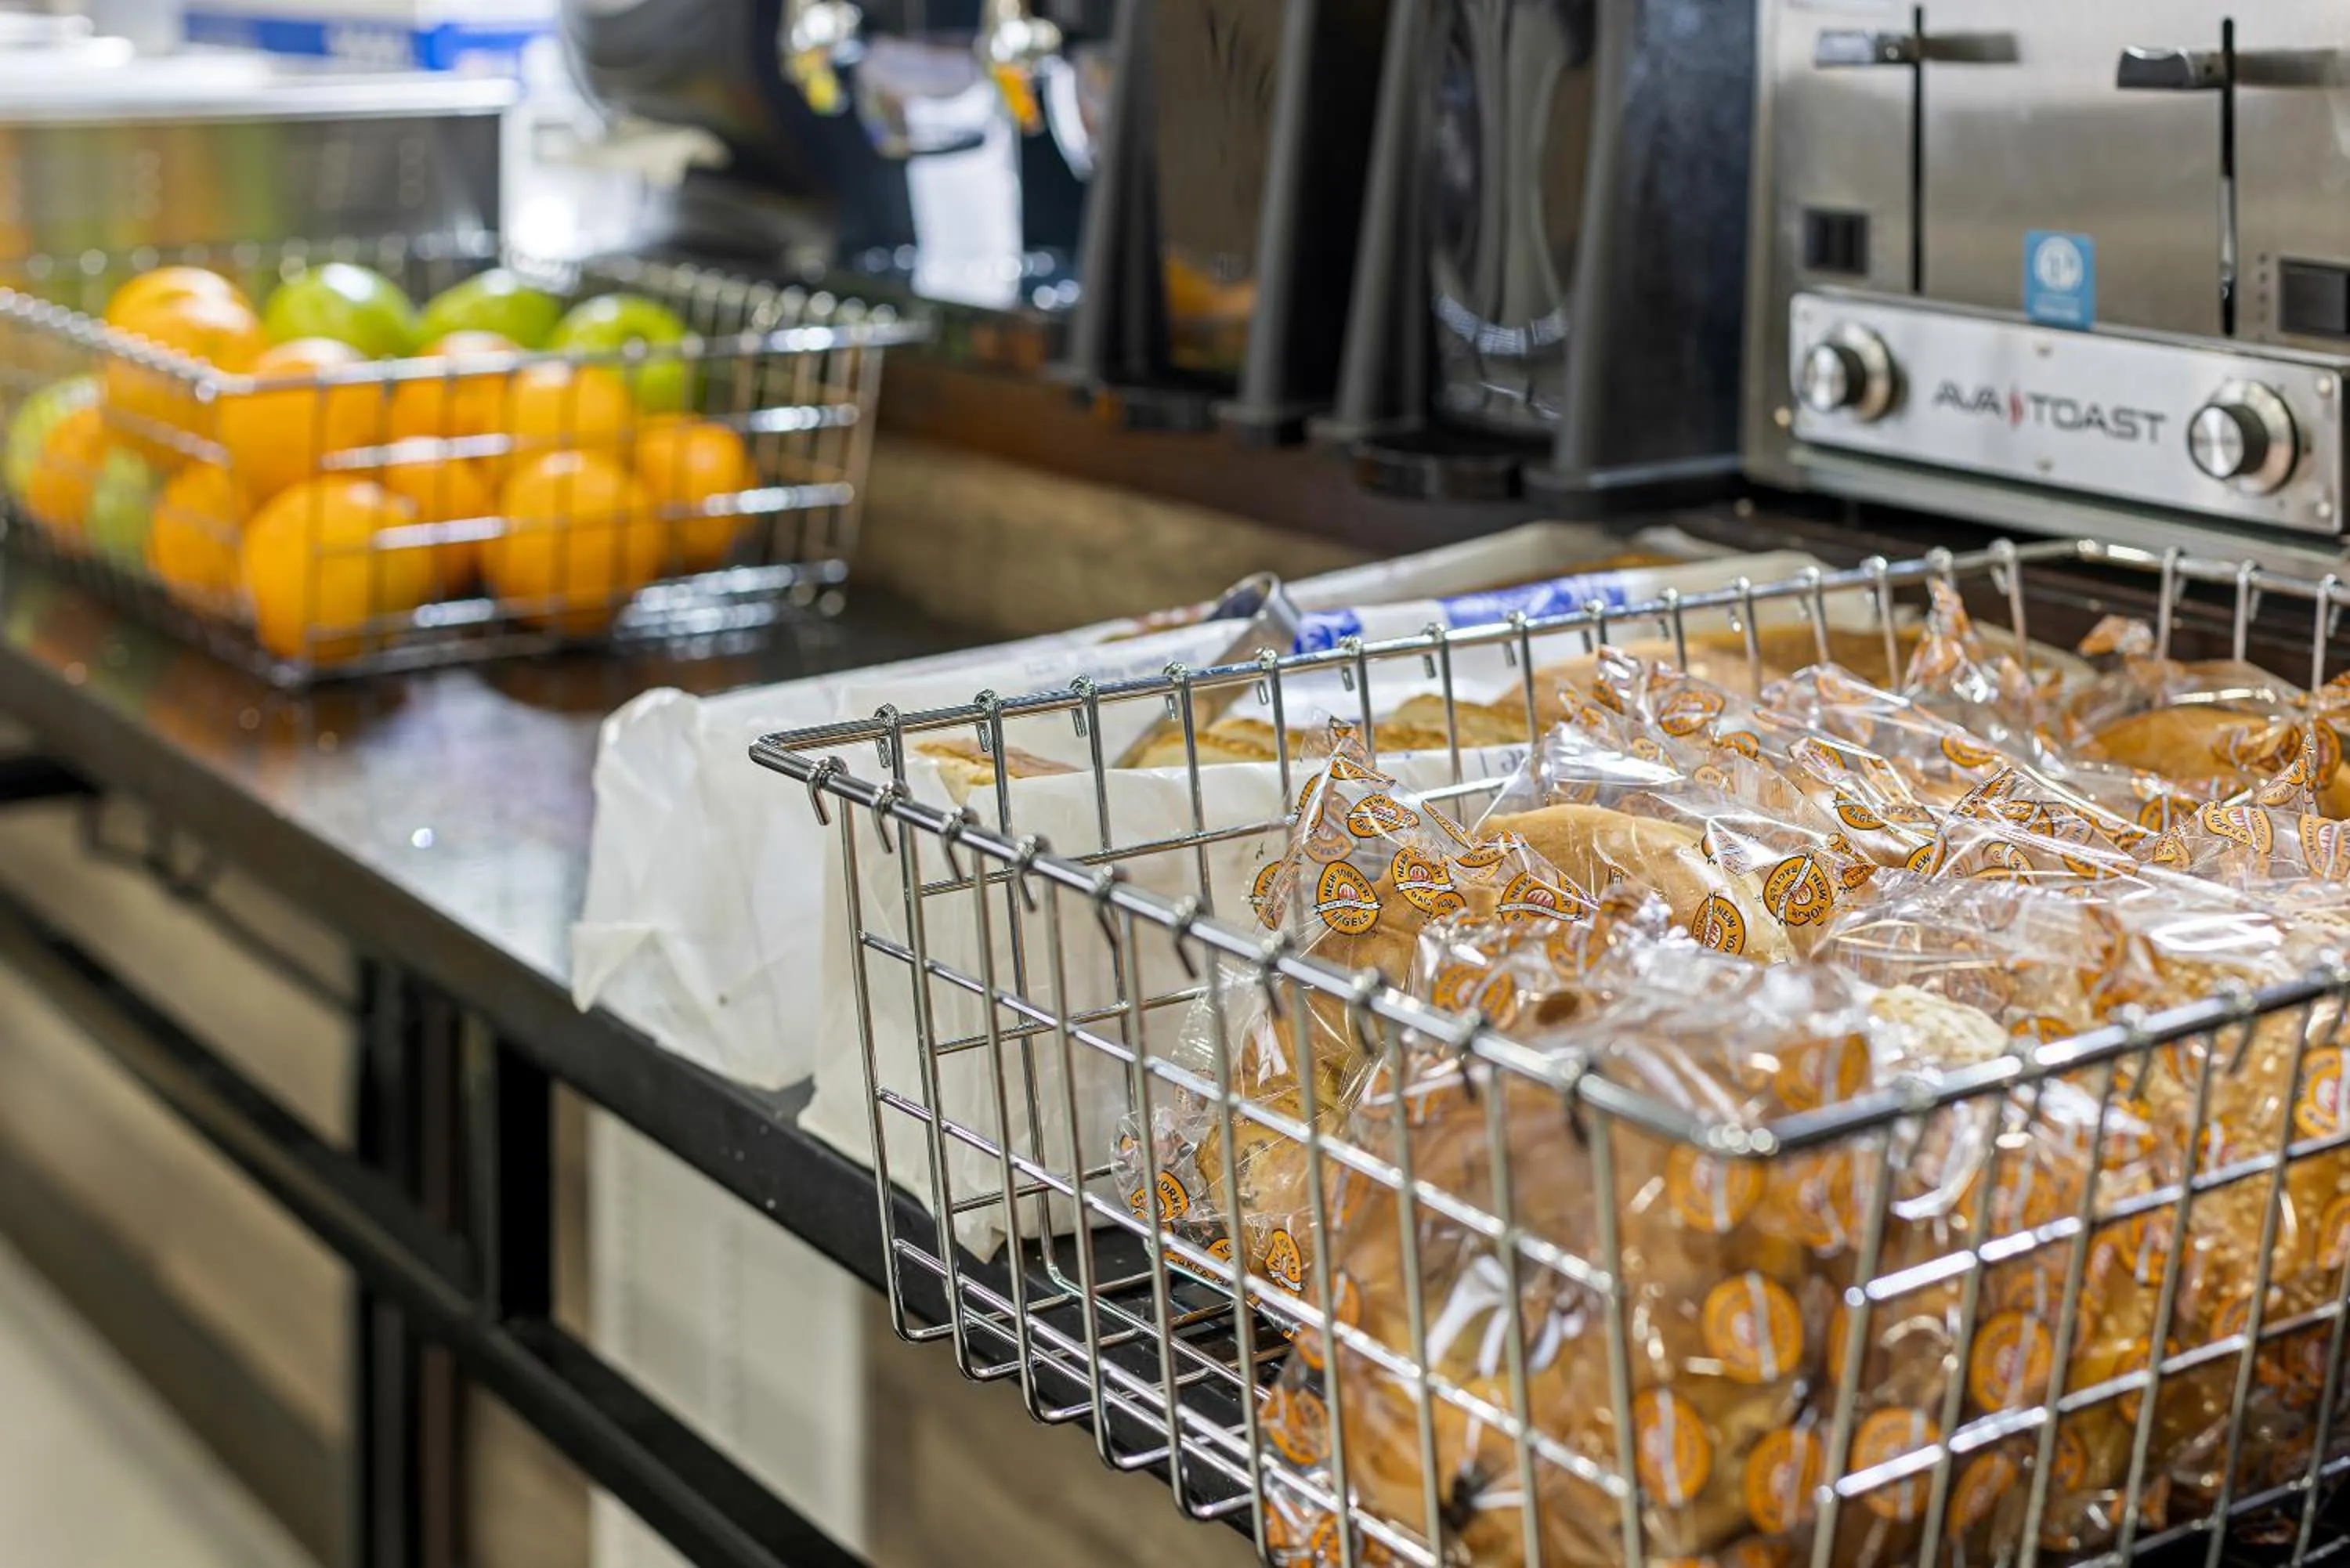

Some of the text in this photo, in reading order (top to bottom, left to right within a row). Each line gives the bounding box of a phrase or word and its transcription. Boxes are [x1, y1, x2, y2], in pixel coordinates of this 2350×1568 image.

[2028, 392, 2167, 443] TOAST
[1847, 806, 1878, 822] BAGE
[1324, 871, 1338, 897] NEW
[1810, 872, 1828, 902] NEW
[1716, 905, 1737, 929] NEW
[1157, 1178, 1183, 1212] ORKE
